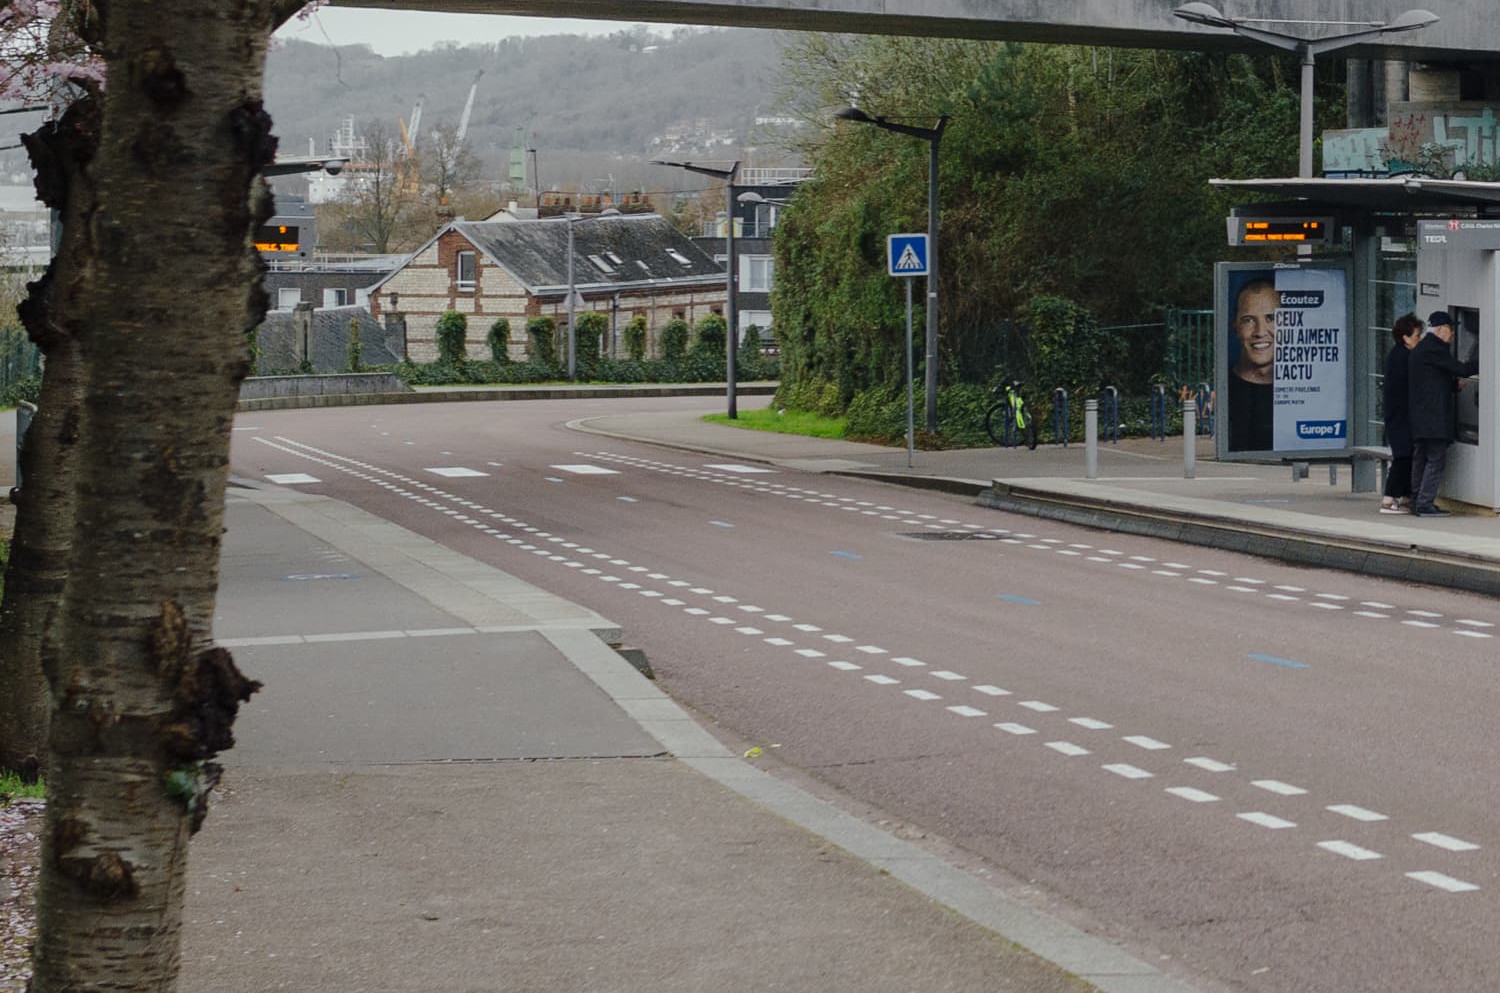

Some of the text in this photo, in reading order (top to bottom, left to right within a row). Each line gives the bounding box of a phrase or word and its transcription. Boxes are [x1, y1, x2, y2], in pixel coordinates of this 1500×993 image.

[1281, 292, 1319, 304] Écoutez
[1276, 311, 1304, 326] CEUX
[1276, 328, 1339, 345] QUI AIMENT
[1275, 364, 1312, 380] L'ACTU
[1300, 424, 1333, 436] Europe
